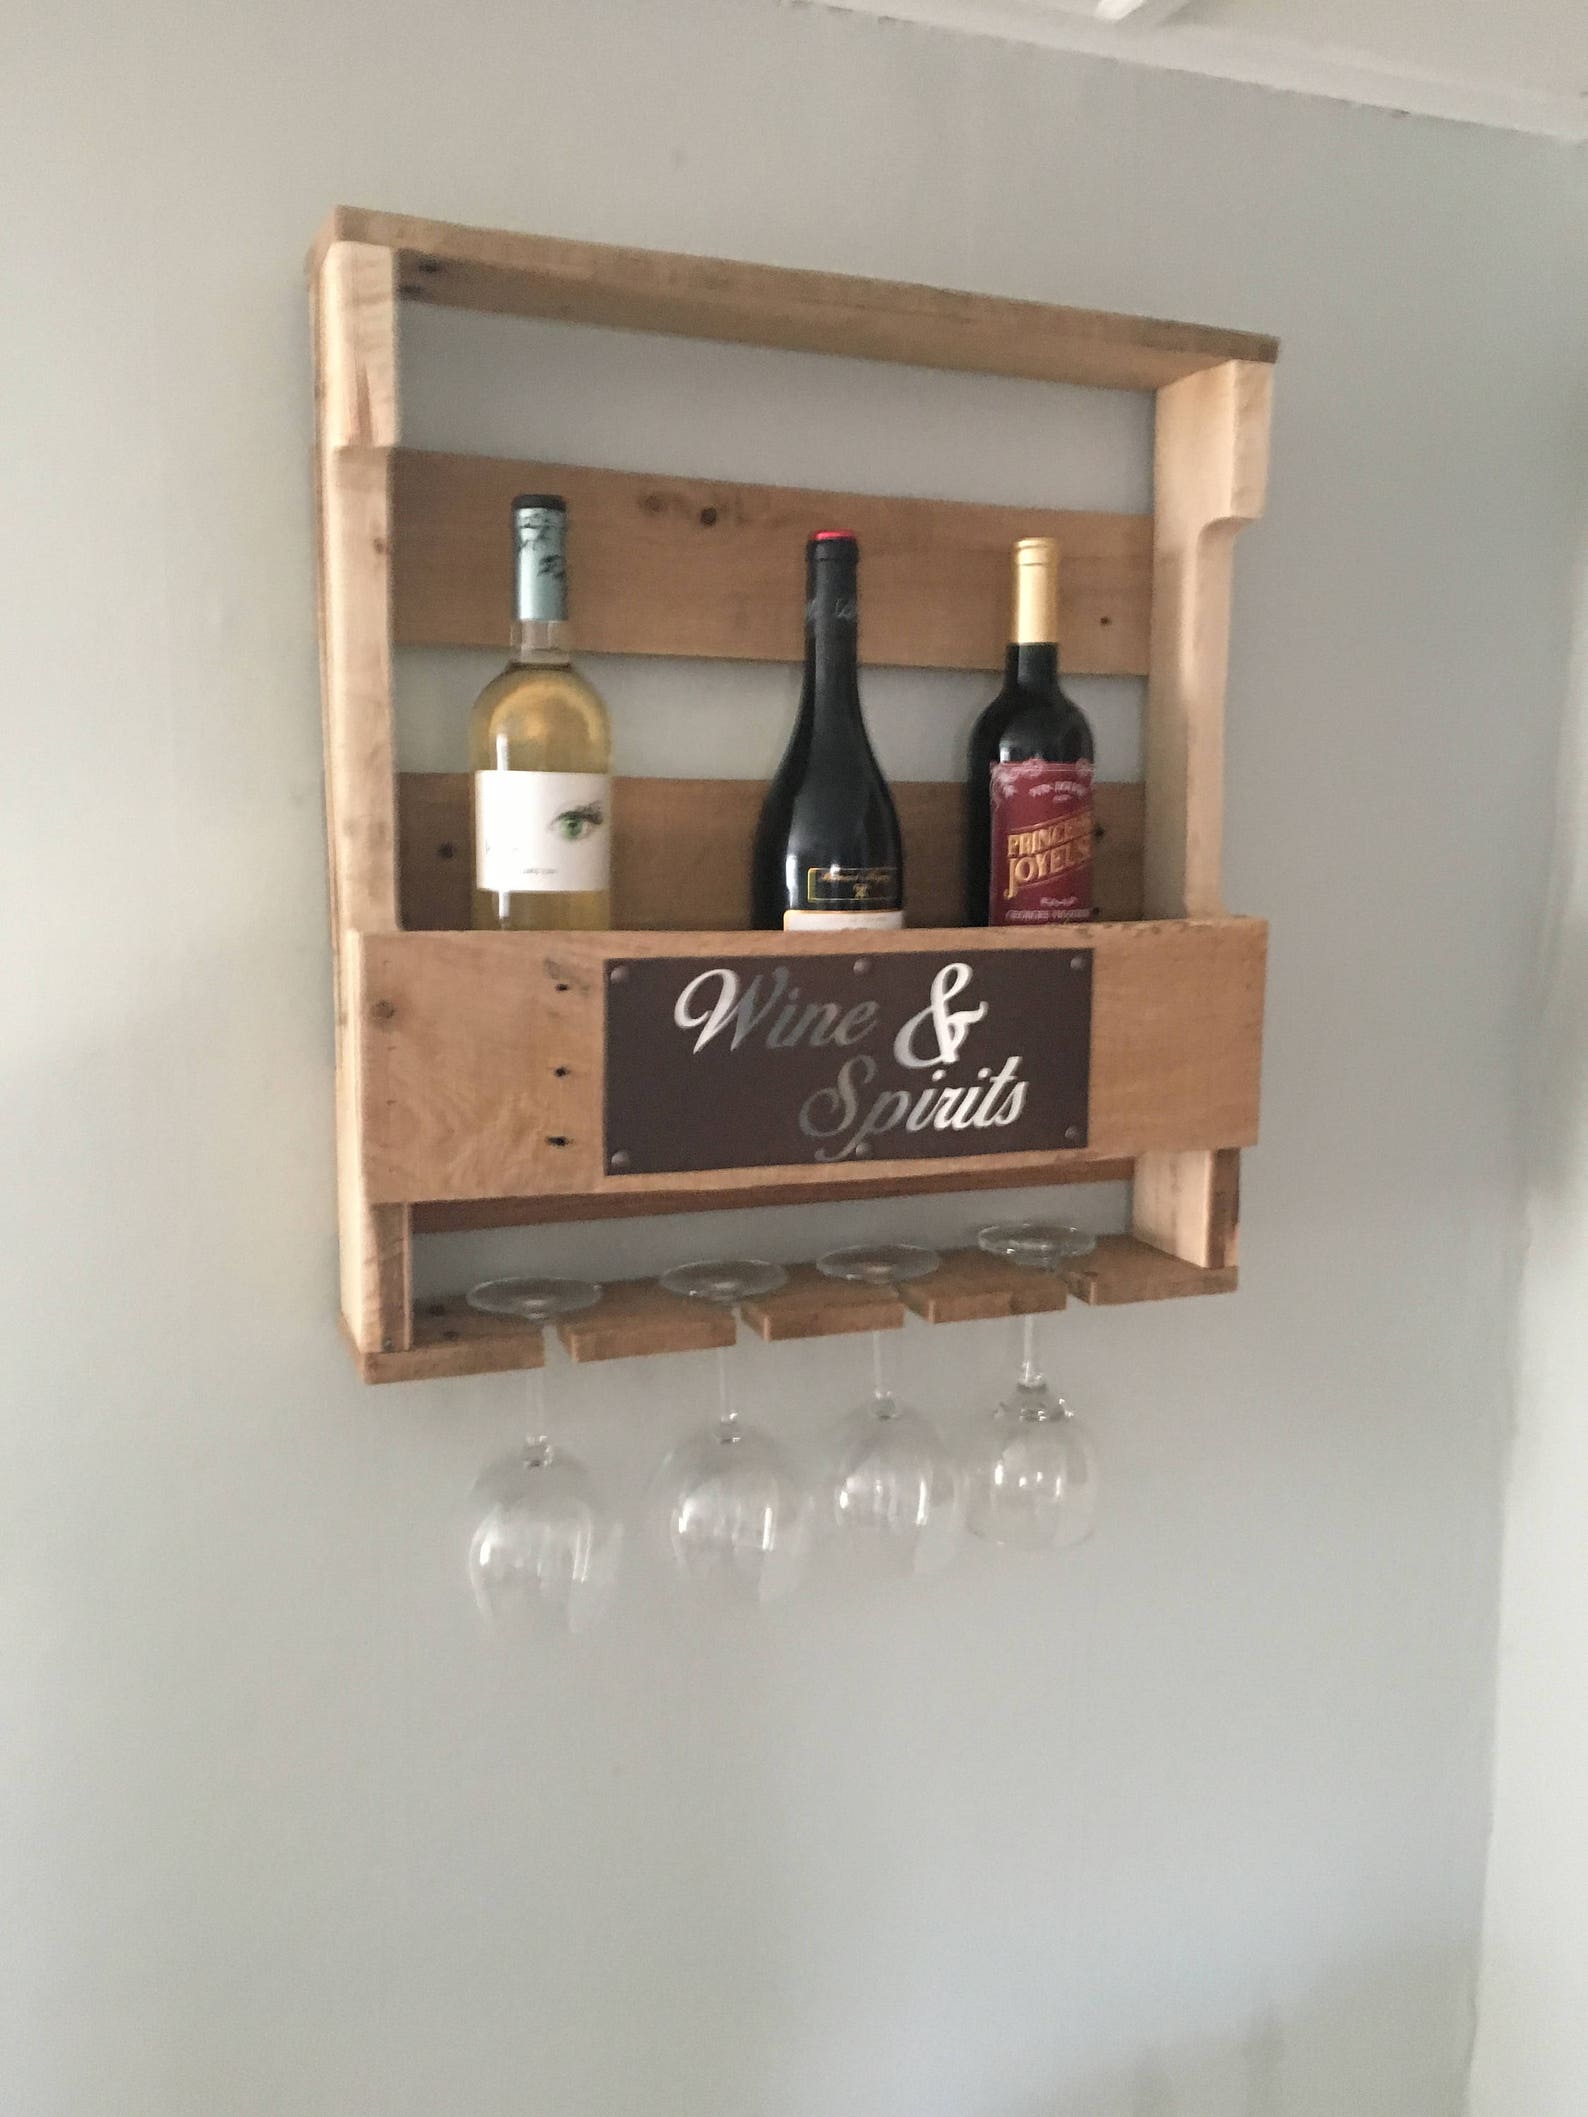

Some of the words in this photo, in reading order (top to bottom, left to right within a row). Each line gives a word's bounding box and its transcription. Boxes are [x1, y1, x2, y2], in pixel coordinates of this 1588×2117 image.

[673, 965, 880, 1055] Wine
[892, 962, 989, 1070] &
[798, 1055, 1030, 1163] Spirits
